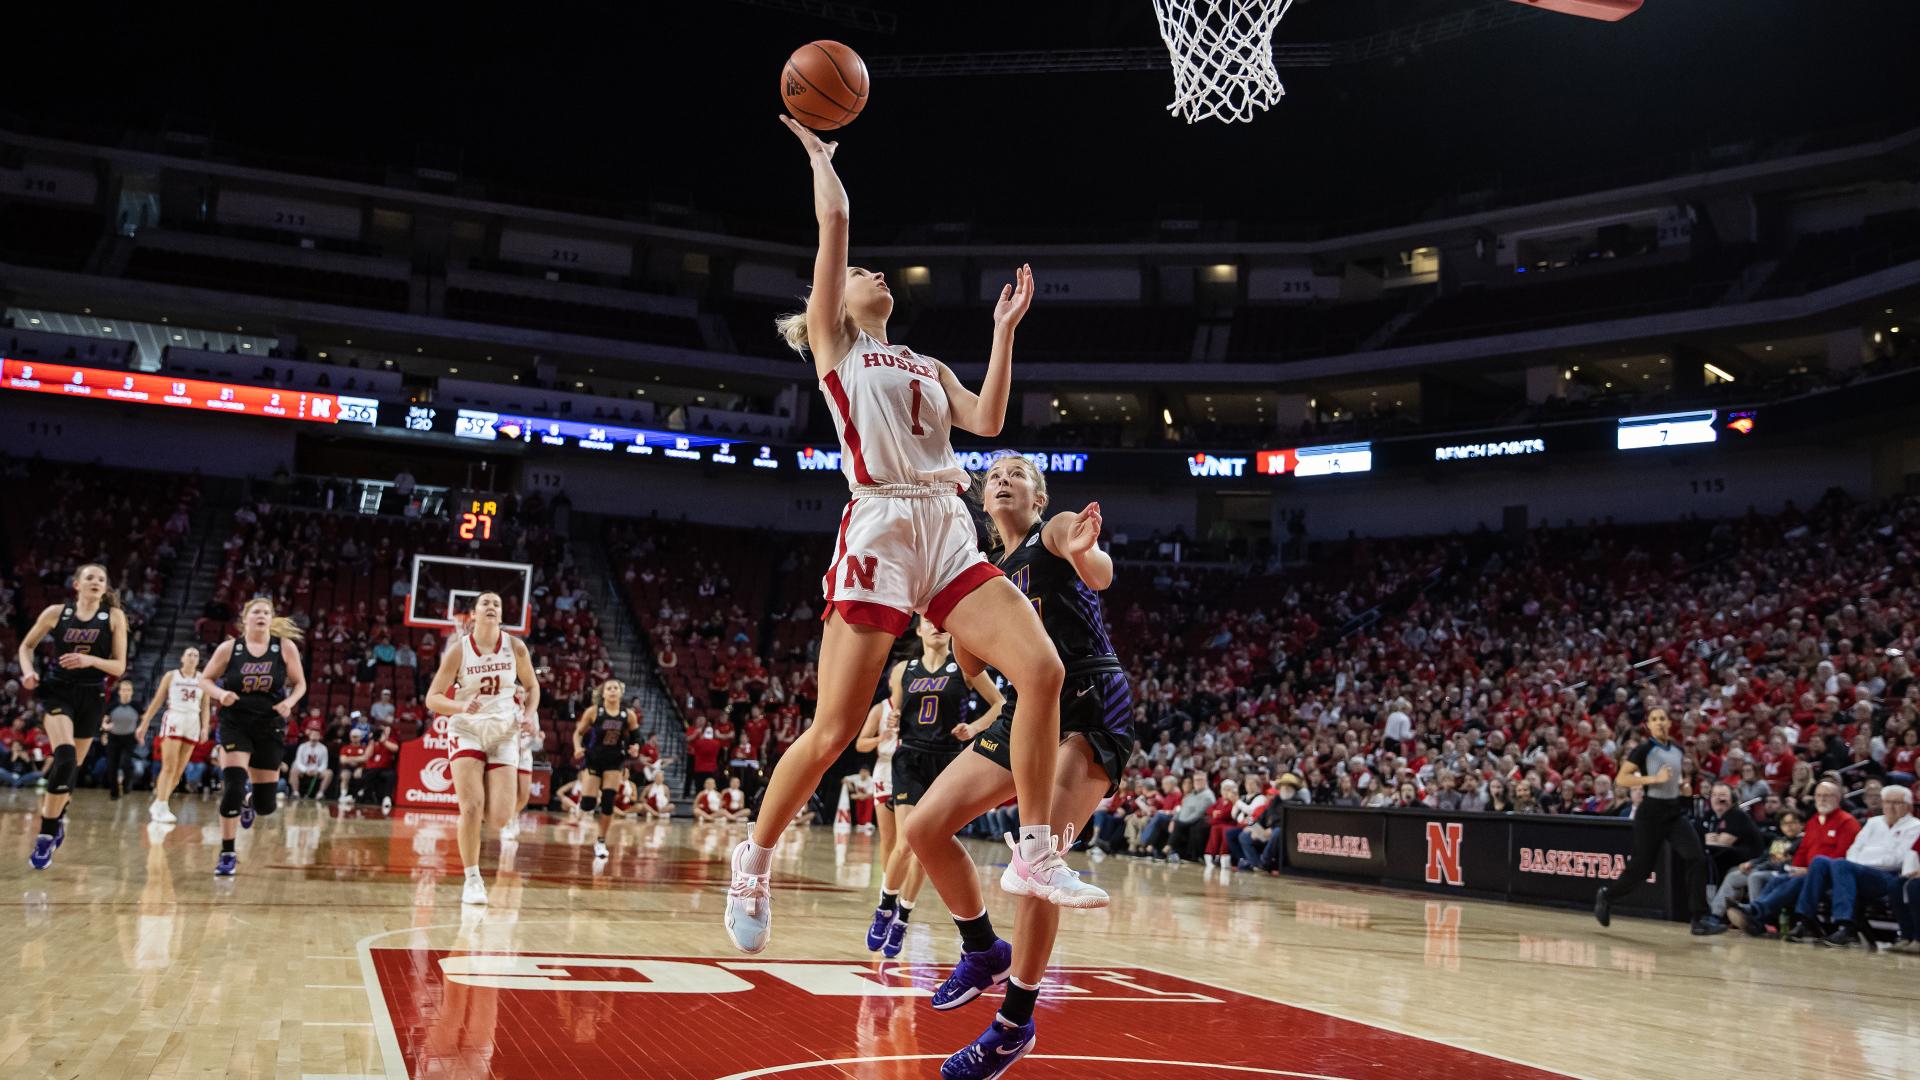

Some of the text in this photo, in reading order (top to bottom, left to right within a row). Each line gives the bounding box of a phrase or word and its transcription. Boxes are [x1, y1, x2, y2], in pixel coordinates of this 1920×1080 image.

[551, 249, 579, 264] 212
[1282, 281, 1311, 293] 215
[311, 397, 332, 418] N
[347, 405, 371, 420] 56
[908, 379, 925, 436] 1
[1660, 430, 1668, 442] 7
[1435, 438, 1545, 461] BENCH POINTS
[1188, 454, 1247, 476] WNIT
[1268, 455, 1285, 474] N
[533, 473, 560, 488] 112
[1690, 478, 1725, 494] 115
[459, 512, 492, 541] 27
[843, 554, 879, 593] N
[63, 628, 101, 643] UNI
[239, 660, 273, 676] UNI
[466, 662, 513, 675] HUSKERS
[480, 674, 501, 696] 21
[907, 675, 951, 694] UNI
[180, 688, 197, 702] 34
[918, 694, 939, 725] 0
[449, 736, 460, 752] N
[1296, 832, 1372, 860] NEBRASKA
[1424, 821, 1464, 887] N
[1518, 847, 1656, 884] BASKETBA
